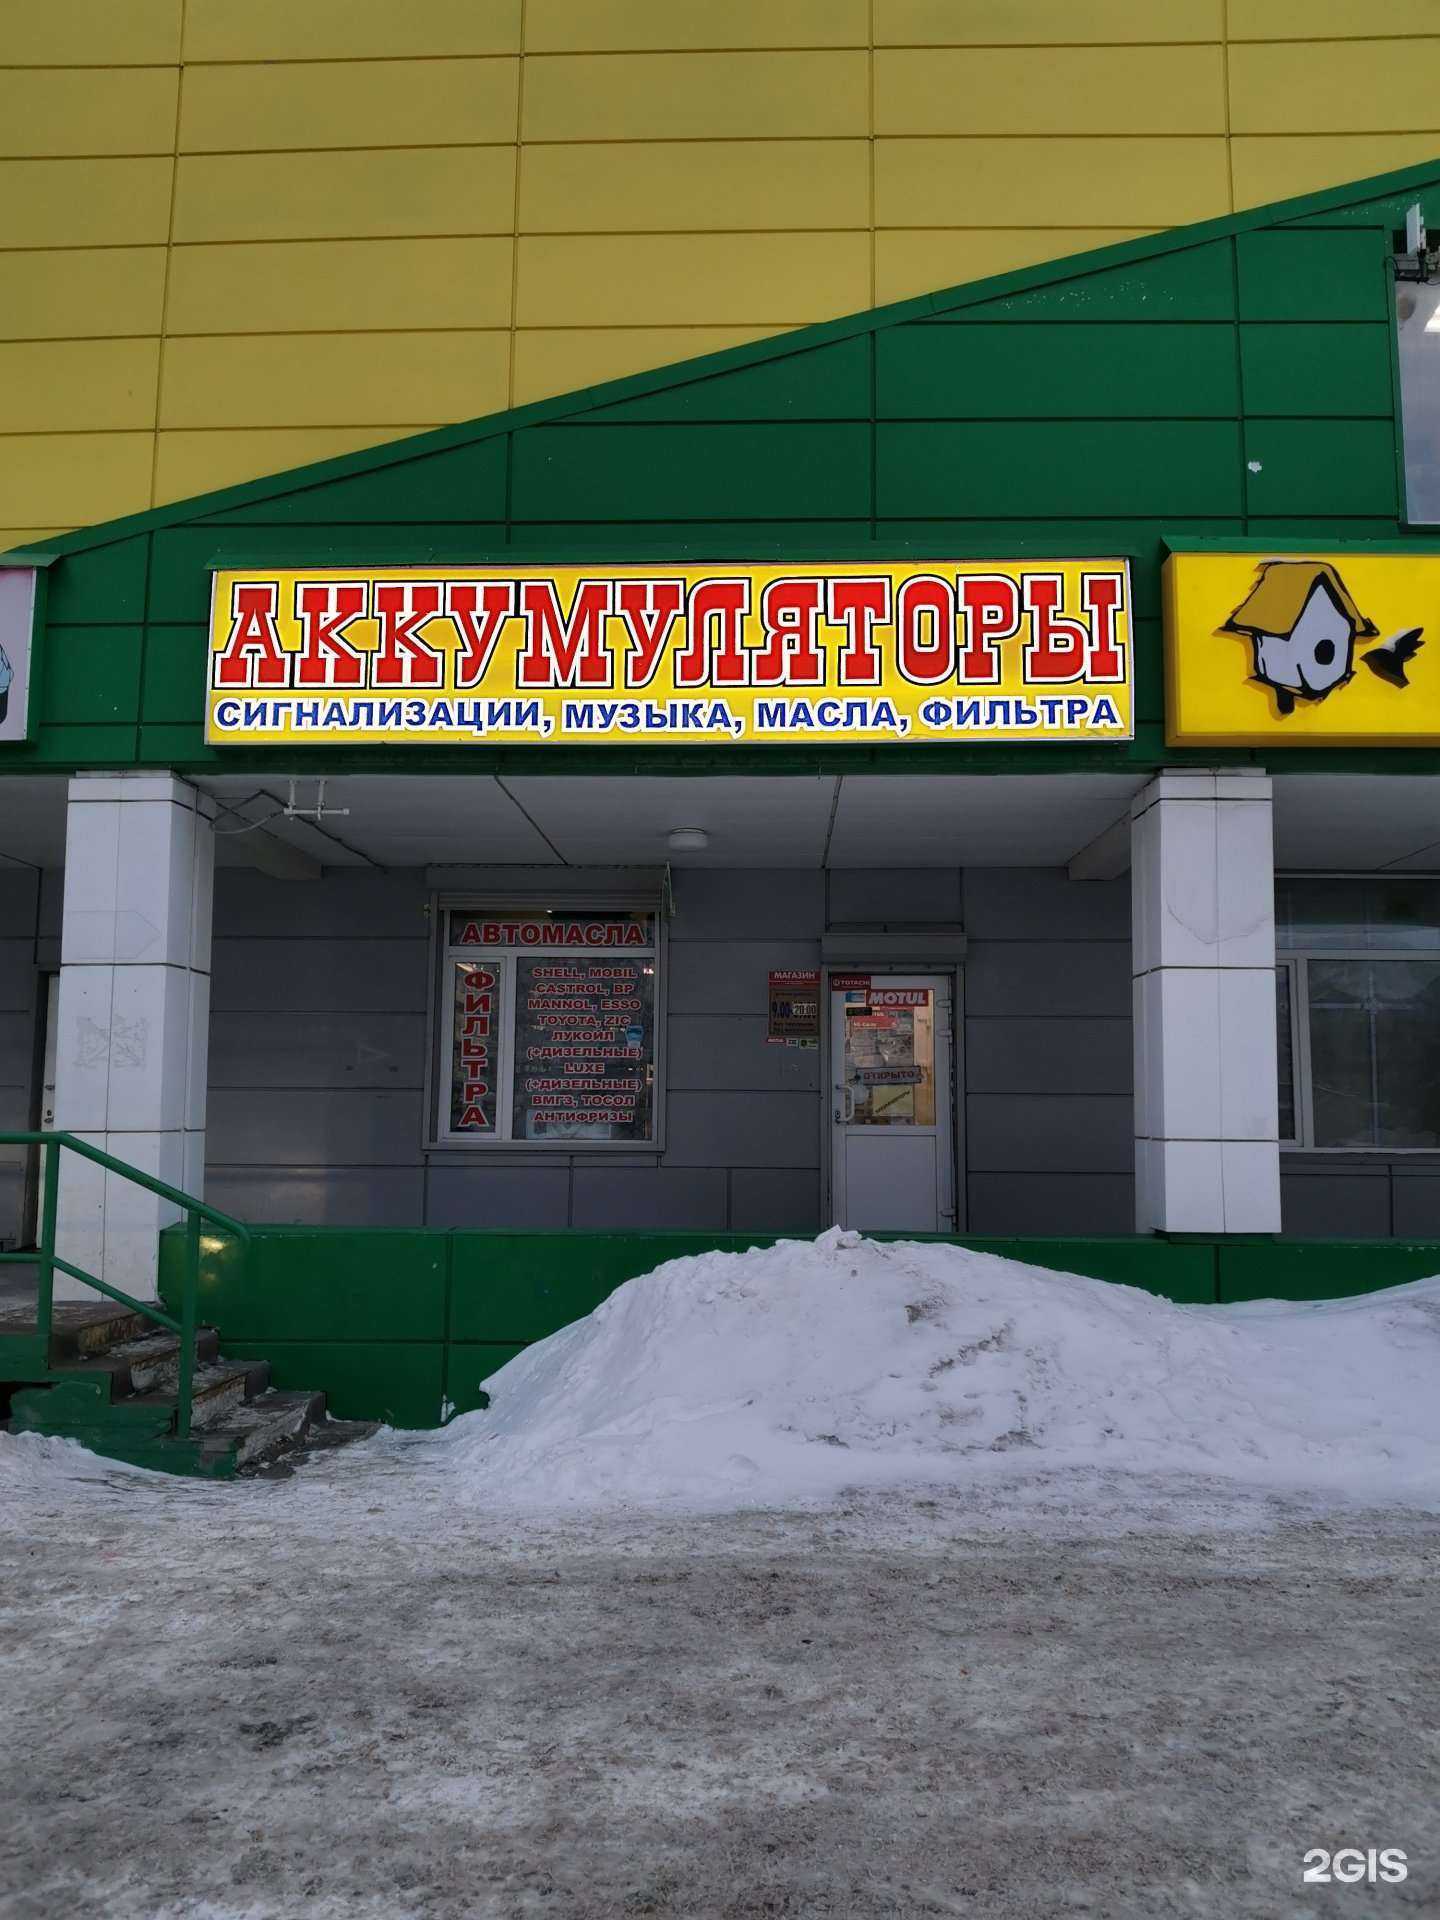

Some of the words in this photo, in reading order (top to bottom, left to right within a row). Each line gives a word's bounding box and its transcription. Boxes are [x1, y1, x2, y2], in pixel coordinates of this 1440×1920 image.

[214, 573, 1128, 689] АККУМУЛЯТОРЫ
[216, 697, 554, 734] СИГНАЛИЗАЦИИ,
[565, 698, 742, 736] МУЗЫКА,
[755, 697, 908, 735] МАСЛА,
[921, 694, 1120, 730] ФИЛЬТРА
[461, 922, 646, 946] АВТОМАСЛА
[532, 967, 586, 980] SHELL,
[774, 971, 816, 980] МАГАЗИН
[535, 983, 610, 996] CASTROL,
[613, 983, 635, 995] BP
[527, 998, 598, 1012] MANNOL,
[600, 998, 641, 1011] ESSO
[868, 991, 927, 1005] MOTUL
[537, 1014, 602, 1028] TOYOTA,
[603, 1014, 632, 1026] ZIC
[457, 970, 496, 1128] ФИЛЬТРА
[563, 1062, 605, 1074] LUXE
[582, 1094, 635, 1106] ТОСОЛ
[533, 1110, 634, 1123] АНТИФРИЗЫ
